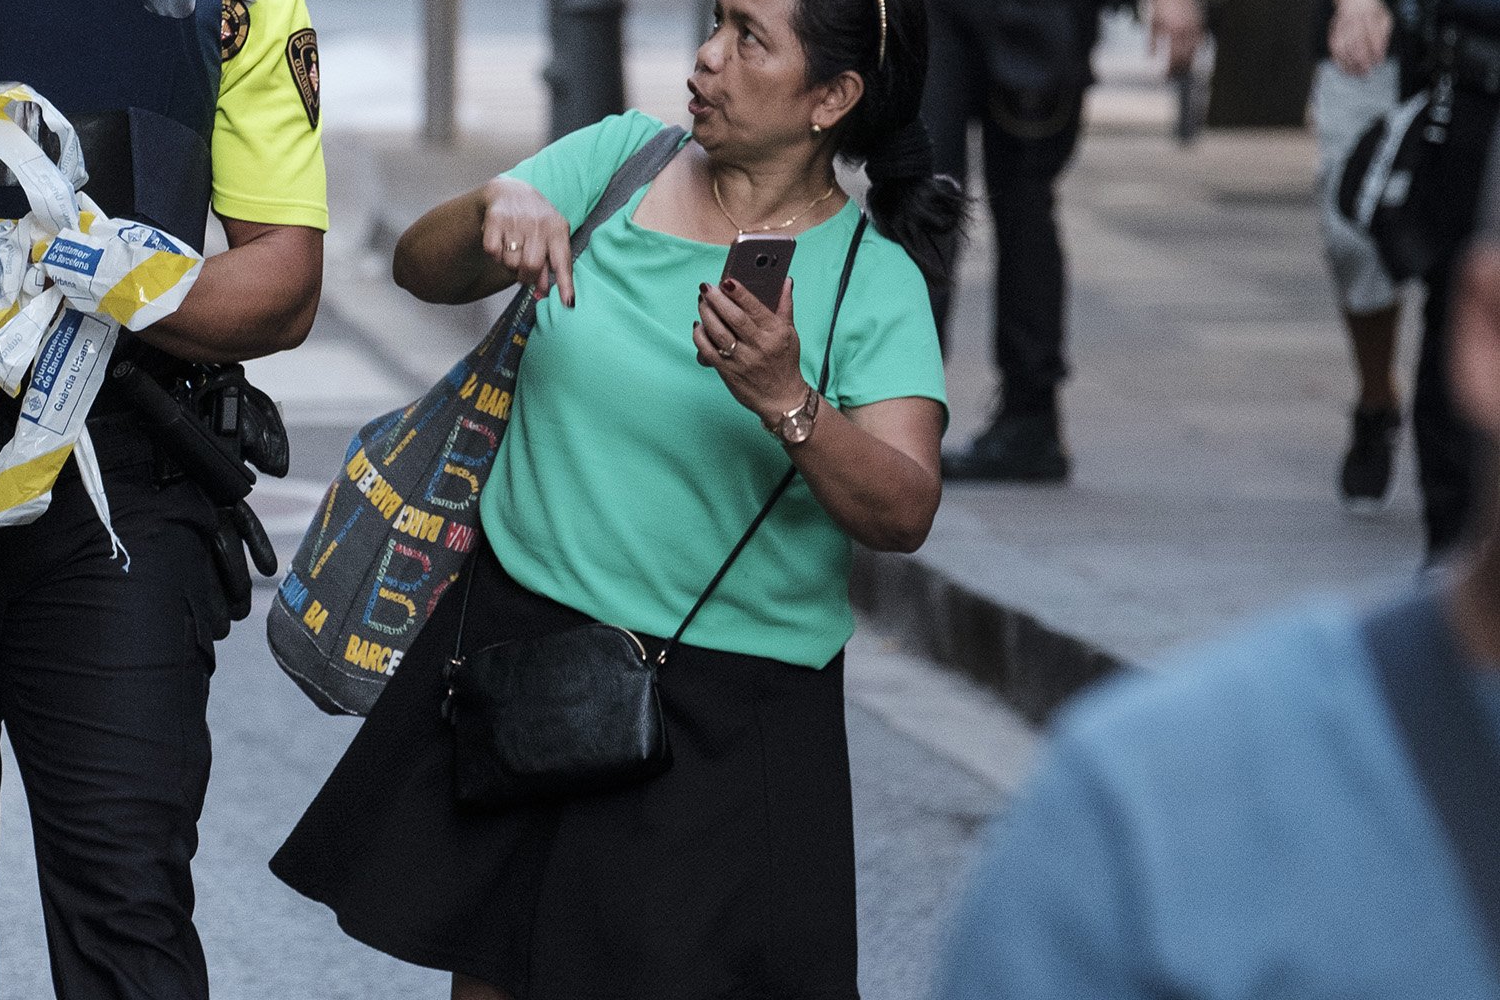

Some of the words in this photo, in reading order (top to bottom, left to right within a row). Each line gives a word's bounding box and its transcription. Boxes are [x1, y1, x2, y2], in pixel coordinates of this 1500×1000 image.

[56, 254, 90, 271] Barcelona
[47, 326, 74, 375] Barcelona
[42, 373, 53, 389] de
[54, 375, 77, 412] Guàrdia
